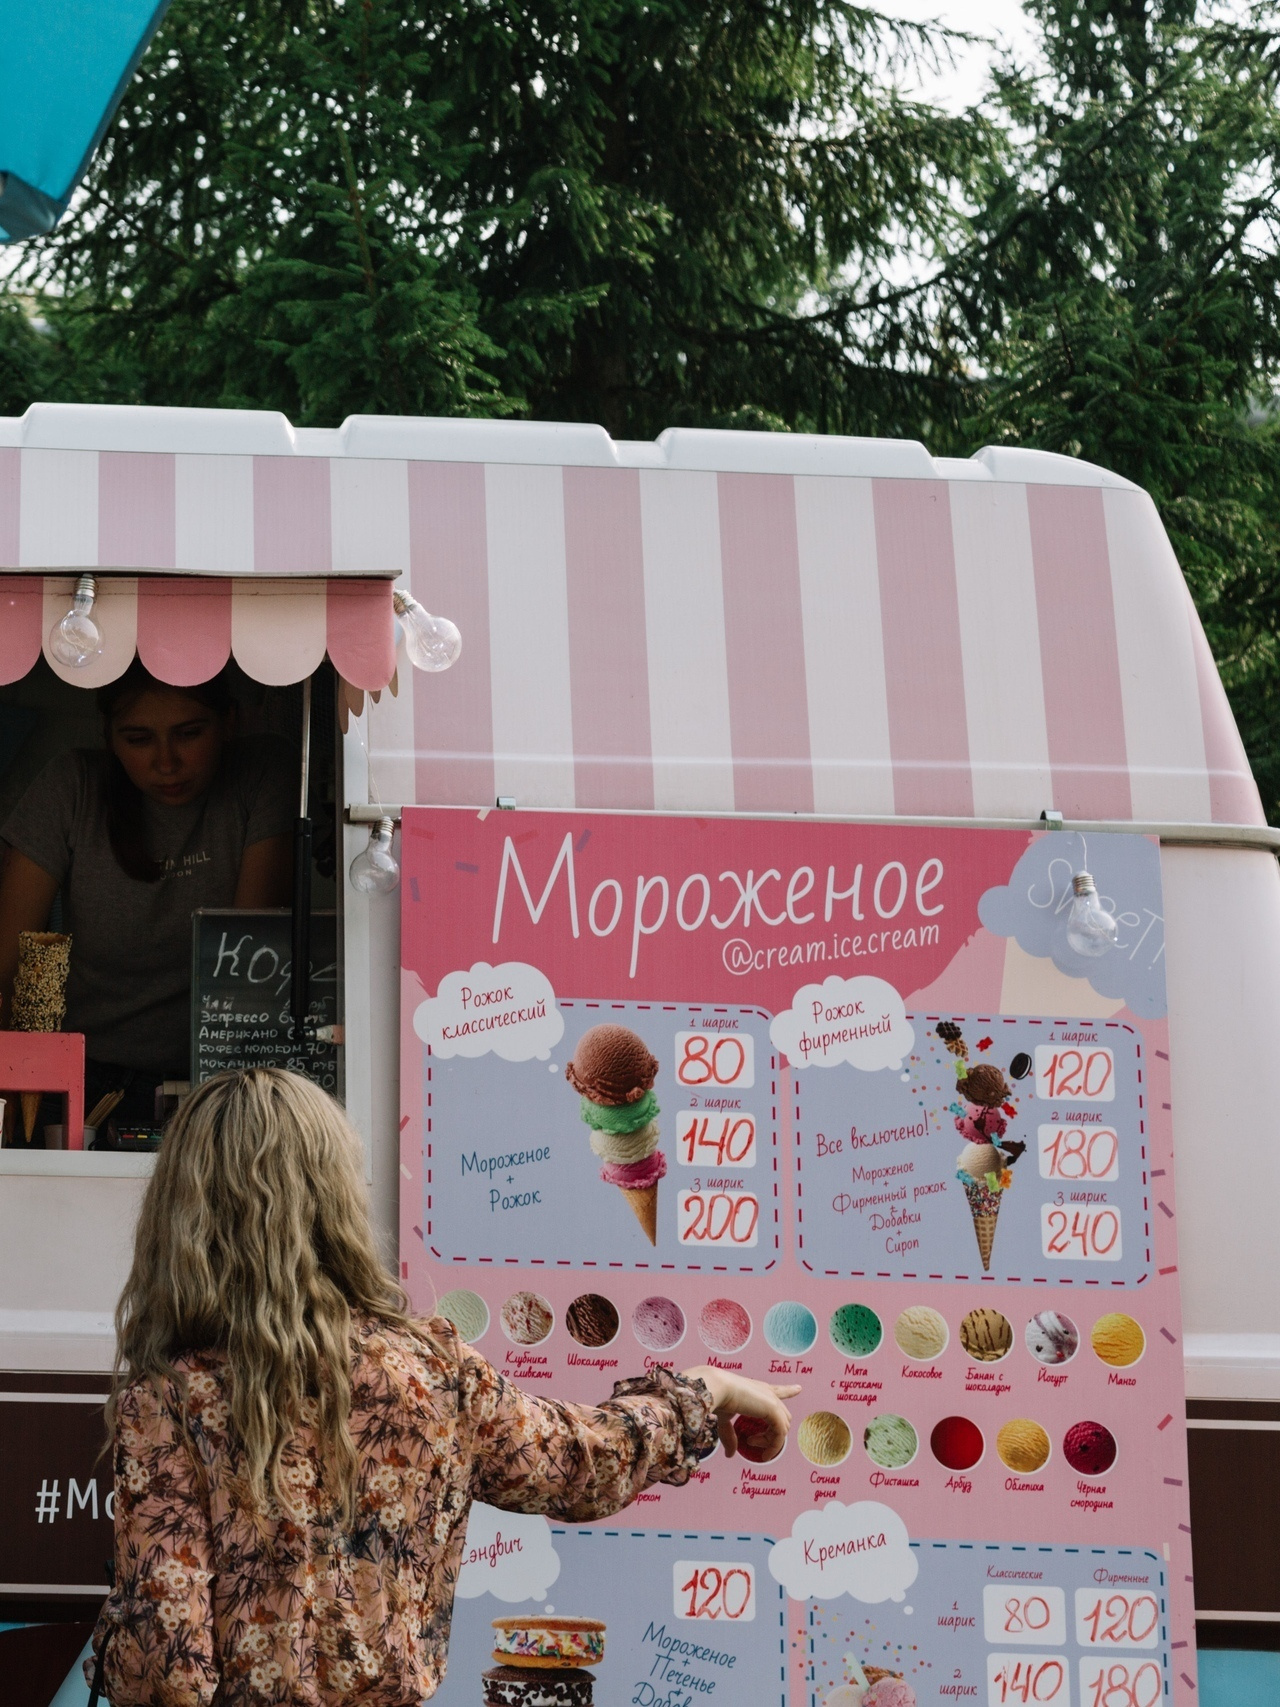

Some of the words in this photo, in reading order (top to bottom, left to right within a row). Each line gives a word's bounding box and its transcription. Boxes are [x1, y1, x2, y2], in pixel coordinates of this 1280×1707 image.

[183, 851, 211, 867] HILL
[492, 832, 945, 979] Мороженое
[722, 924, 940, 976] @cream.ice.cream
[460, 986, 514, 1010] Рожок
[441, 998, 547, 1041] классический
[812, 1000, 865, 1024] Рожок
[689, 1018, 696, 1028] 1
[701, 1017, 739, 1032] шарик
[799, 1013, 892, 1061] фирменный
[1048, 1032, 1055, 1041] 1
[1061, 1030, 1099, 1045] шарик
[677, 1034, 746, 1086] 80
[1043, 1050, 1113, 1098] 120
[689, 1097, 699, 1108] 2
[705, 1096, 742, 1111] шарик
[1052, 1112, 1062, 1122] 2
[1066, 1110, 1103, 1125] шарик
[682, 1116, 756, 1167] 140
[816, 1133, 843, 1158] Все
[851, 1109, 930, 1150] включено!
[461, 1146, 551, 1180] Мороженое
[1043, 1128, 1119, 1180] 180
[852, 1161, 915, 1186] Мороженое
[691, 1177, 701, 1192] 3
[706, 1177, 745, 1191] шарик
[489, 1188, 542, 1212] Рожок
[832, 1186, 907, 1216] Фирменный
[913, 1181, 948, 1203] рожок
[1054, 1191, 1065, 1205] 3
[1070, 1190, 1107, 1205] шарик
[682, 1192, 760, 1244] 200
[868, 1208, 921, 1231] Добавки
[1046, 1210, 1119, 1258] 240
[885, 1236, 920, 1257] Сироп
[505, 1351, 548, 1366] Клубника
[567, 1353, 619, 1371] Шоколадное
[707, 1356, 743, 1370] Малина
[768, 1359, 792, 1374] Бабл
[795, 1361, 813, 1374] Гам
[513, 1369, 553, 1379] сливками
[844, 1363, 868, 1376] Мята
[902, 1365, 943, 1379] Кокосовое
[965, 1367, 995, 1381] Банан
[1037, 1368, 1068, 1387] Йогурт
[839, 1380, 883, 1393] кусочками
[1108, 1373, 1137, 1386] Манго
[965, 1383, 1011, 1396] шоколадом
[836, 1392, 877, 1406] шоколада
[741, 1468, 777, 1482] Малина
[810, 1471, 840, 1484] Сочная
[869, 1472, 920, 1488] Фисташка
[741, 1482, 787, 1500] базиликом
[944, 1476, 972, 1493] Арбуз
[1004, 1478, 1045, 1491] Облепиха
[1076, 1480, 1106, 1494] Чёрная
[814, 1490, 837, 1502] дыня
[1070, 1499, 1114, 1513] смородина
[803, 1531, 887, 1571] Креманка
[986, 1565, 1044, 1580] Классические
[1093, 1567, 1150, 1586] Фирменные
[681, 1566, 752, 1620] 120
[1004, 1596, 1051, 1633] 80
[1083, 1595, 1159, 1642] 120
[937, 1616, 976, 1632] шарик
[641, 1621, 737, 1669] Мороженое
[650, 1653, 716, 1695] Печенье
[994, 1660, 1064, 1703] 140
[939, 1685, 978, 1701] шарик
[1088, 1663, 1162, 1707] 180
